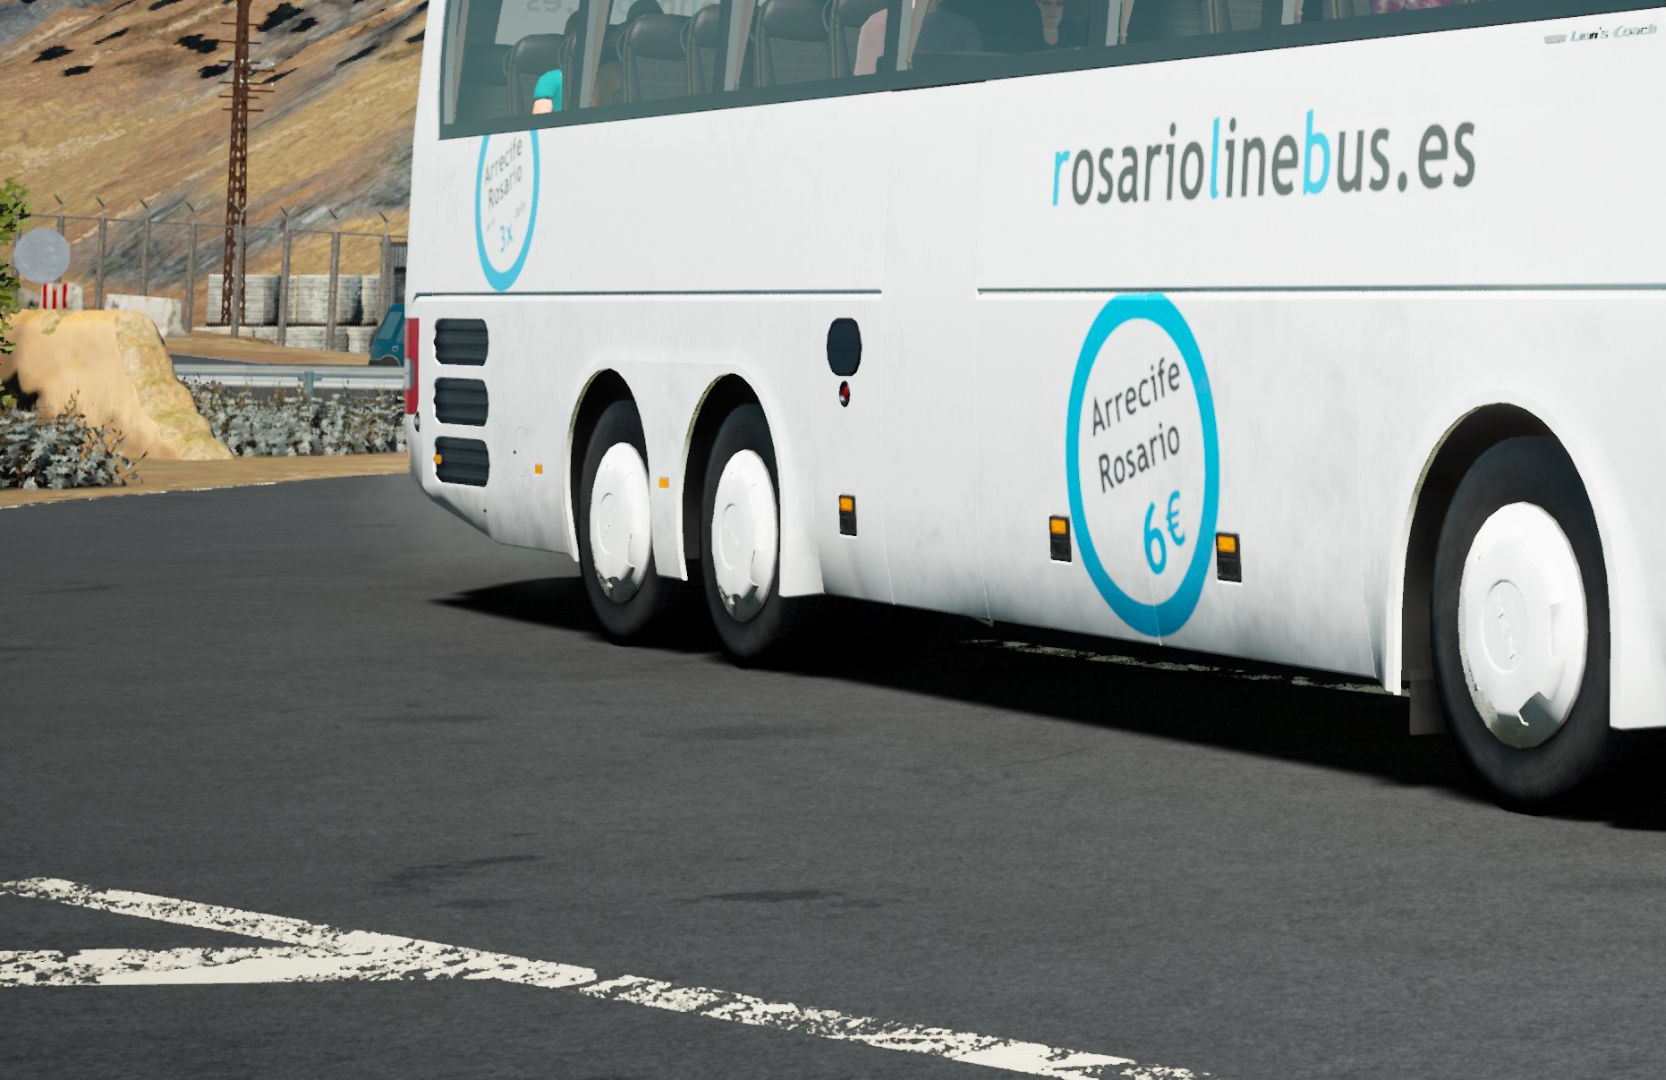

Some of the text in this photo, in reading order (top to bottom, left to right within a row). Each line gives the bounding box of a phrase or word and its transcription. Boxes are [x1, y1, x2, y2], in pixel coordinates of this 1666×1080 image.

[485, 136, 523, 186] Arrecife
[488, 164, 523, 211] Rosario
[1052, 109, 1476, 206] rosariolinebus.es
[1092, 357, 1181, 437] Arrecife
[1098, 423, 1181, 493] Rosario
[1143, 490, 1186, 575] 6€
